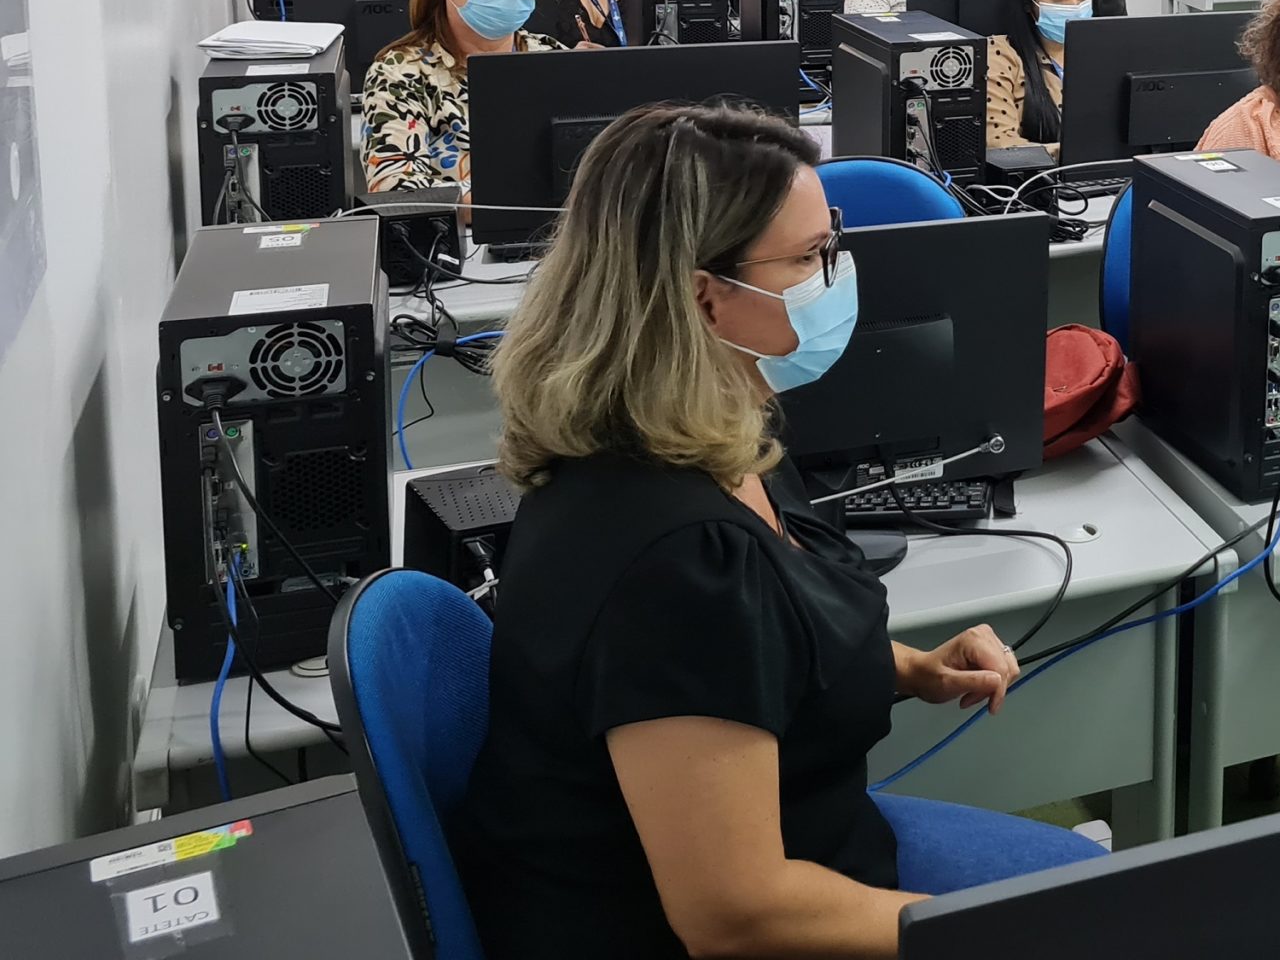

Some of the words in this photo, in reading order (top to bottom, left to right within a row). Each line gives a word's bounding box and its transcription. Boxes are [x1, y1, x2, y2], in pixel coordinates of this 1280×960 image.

[362, 4, 393, 16] AOC
[1135, 80, 1165, 93] AOC
[143, 885, 200, 914] 01
[138, 910, 210, 936] CATETE
